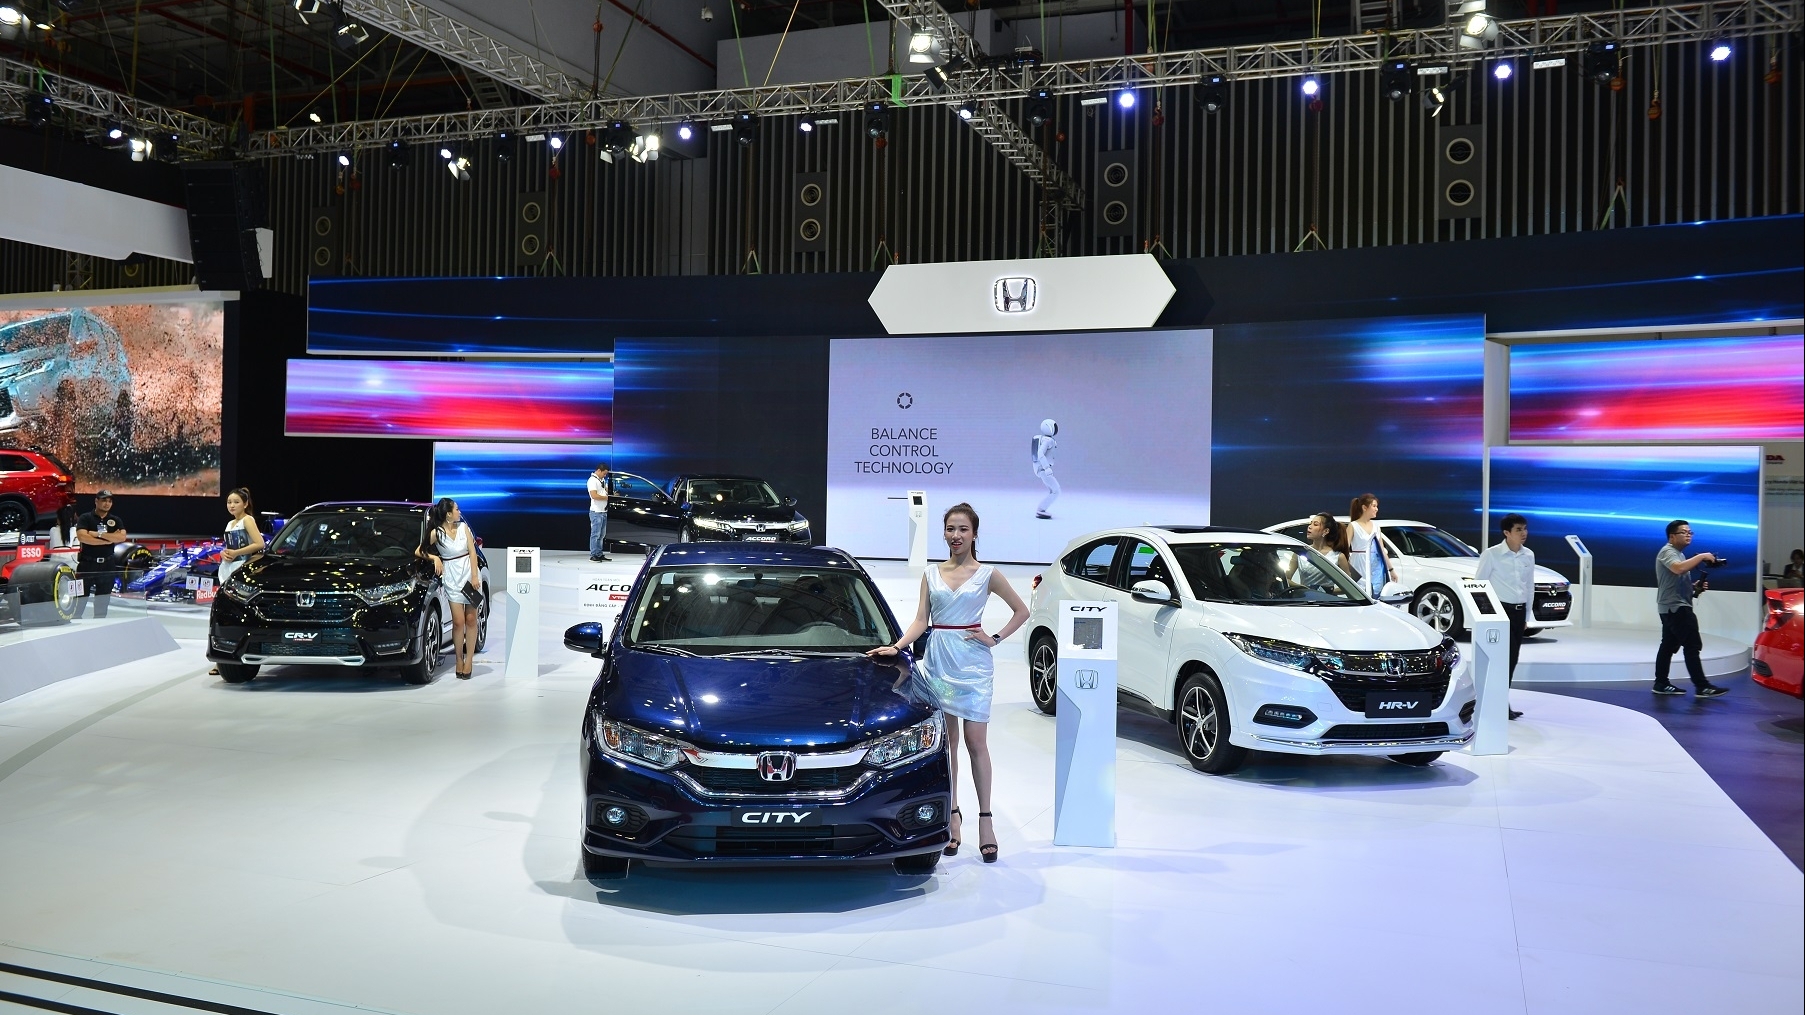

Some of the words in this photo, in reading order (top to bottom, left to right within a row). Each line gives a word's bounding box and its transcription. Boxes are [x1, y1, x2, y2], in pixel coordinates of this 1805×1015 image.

[871, 427, 938, 440] BALANCE
[869, 444, 939, 457] CONTROL
[854, 461, 954, 474] TECHNOLOGY
[21, 547, 42, 558] ESSO
[585, 583, 632, 592] ACCO
[1378, 701, 1419, 710] HR-V
[741, 812, 812, 823] CITY
